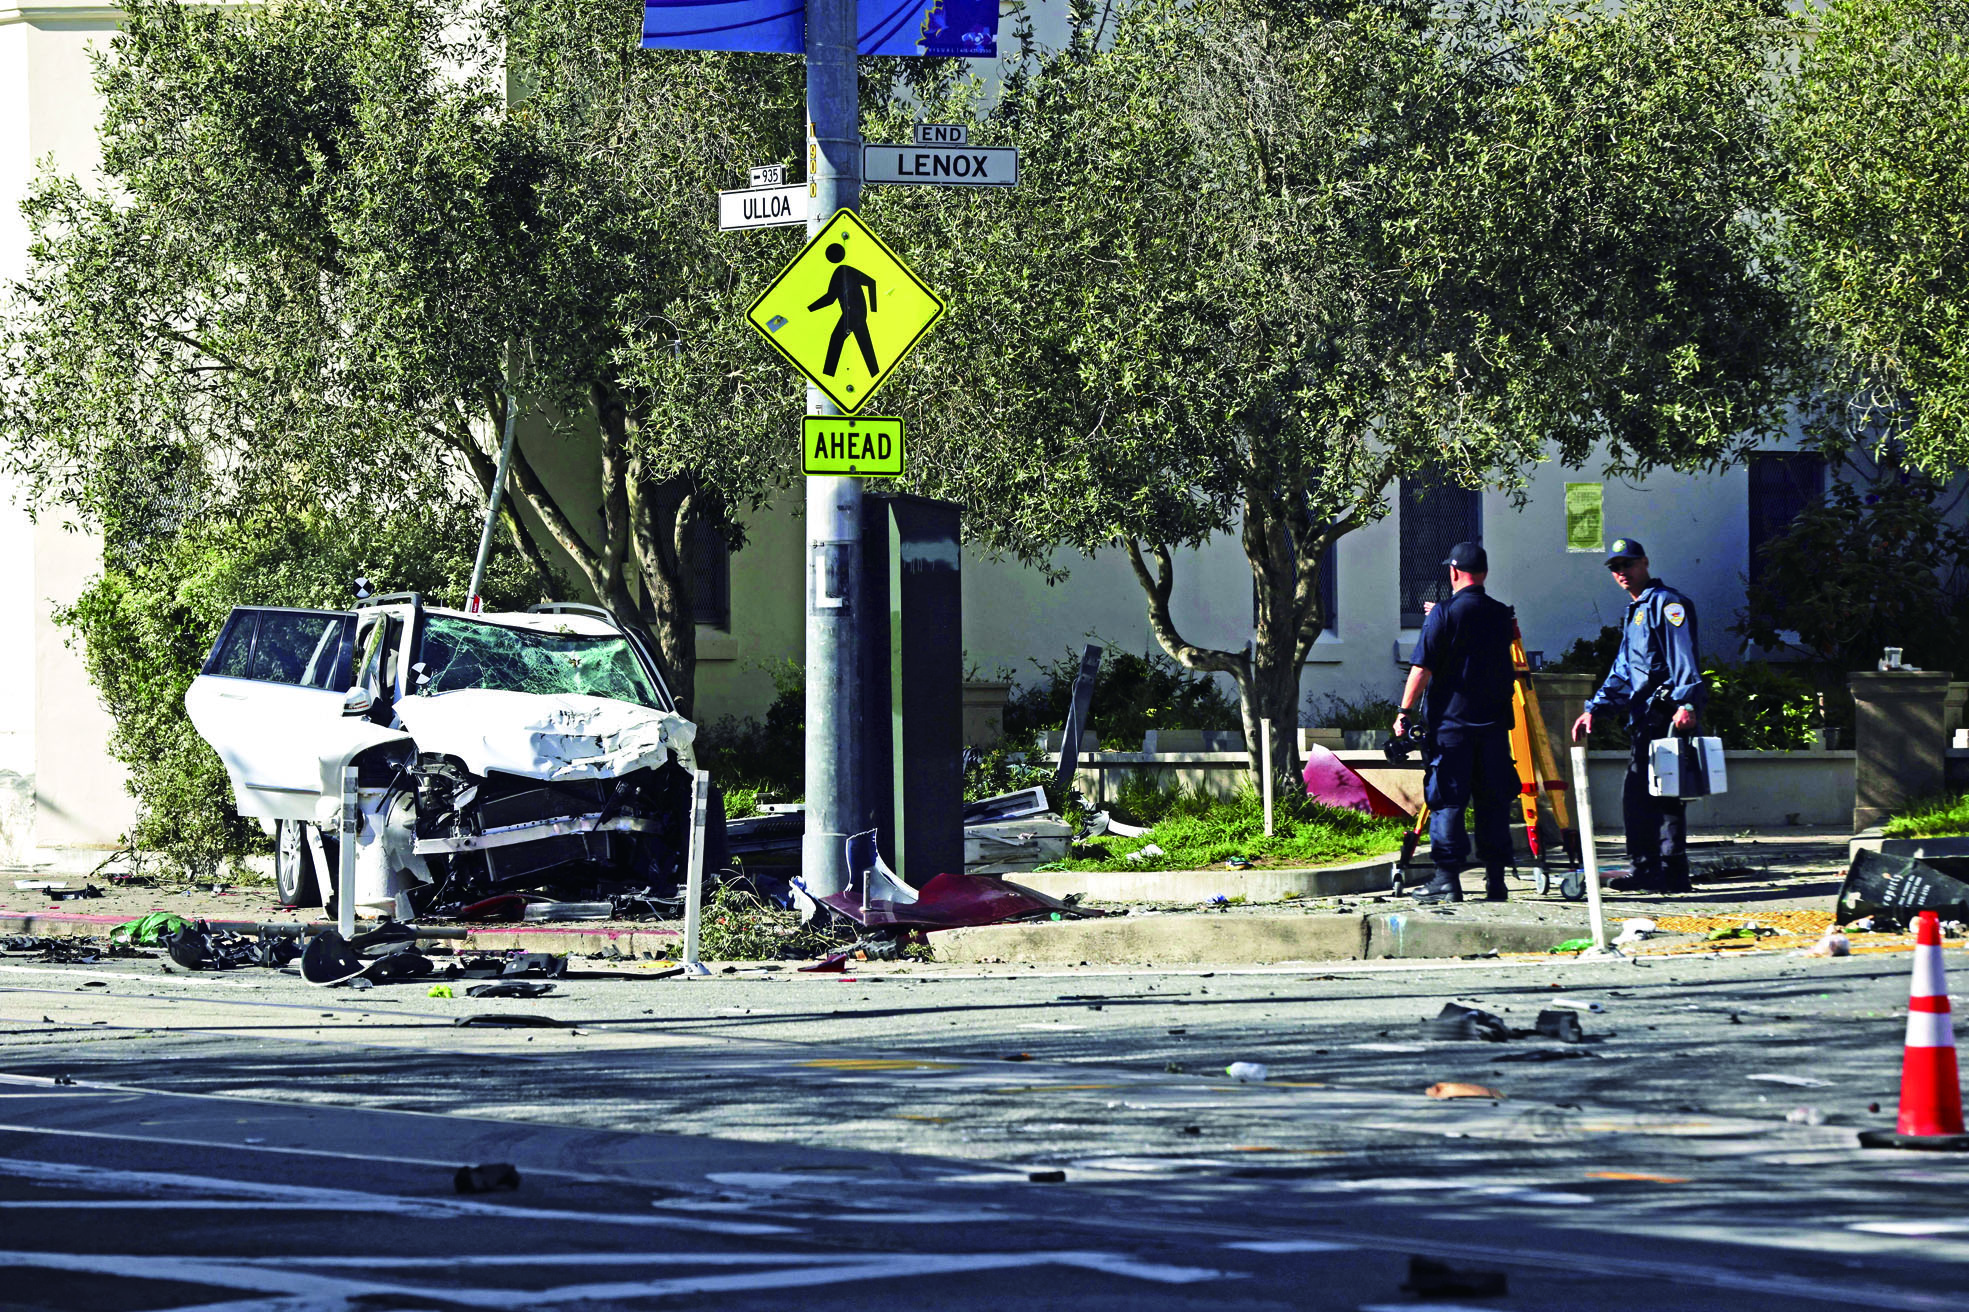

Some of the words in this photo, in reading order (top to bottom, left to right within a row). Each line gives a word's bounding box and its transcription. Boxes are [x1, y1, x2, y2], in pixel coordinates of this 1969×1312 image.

[922, 127, 961, 141] END
[898, 154, 988, 178] LENOX
[743, 195, 791, 220] ULLOA
[814, 432, 891, 460] AHEAD
[1882, 874, 1904, 907] roperty
